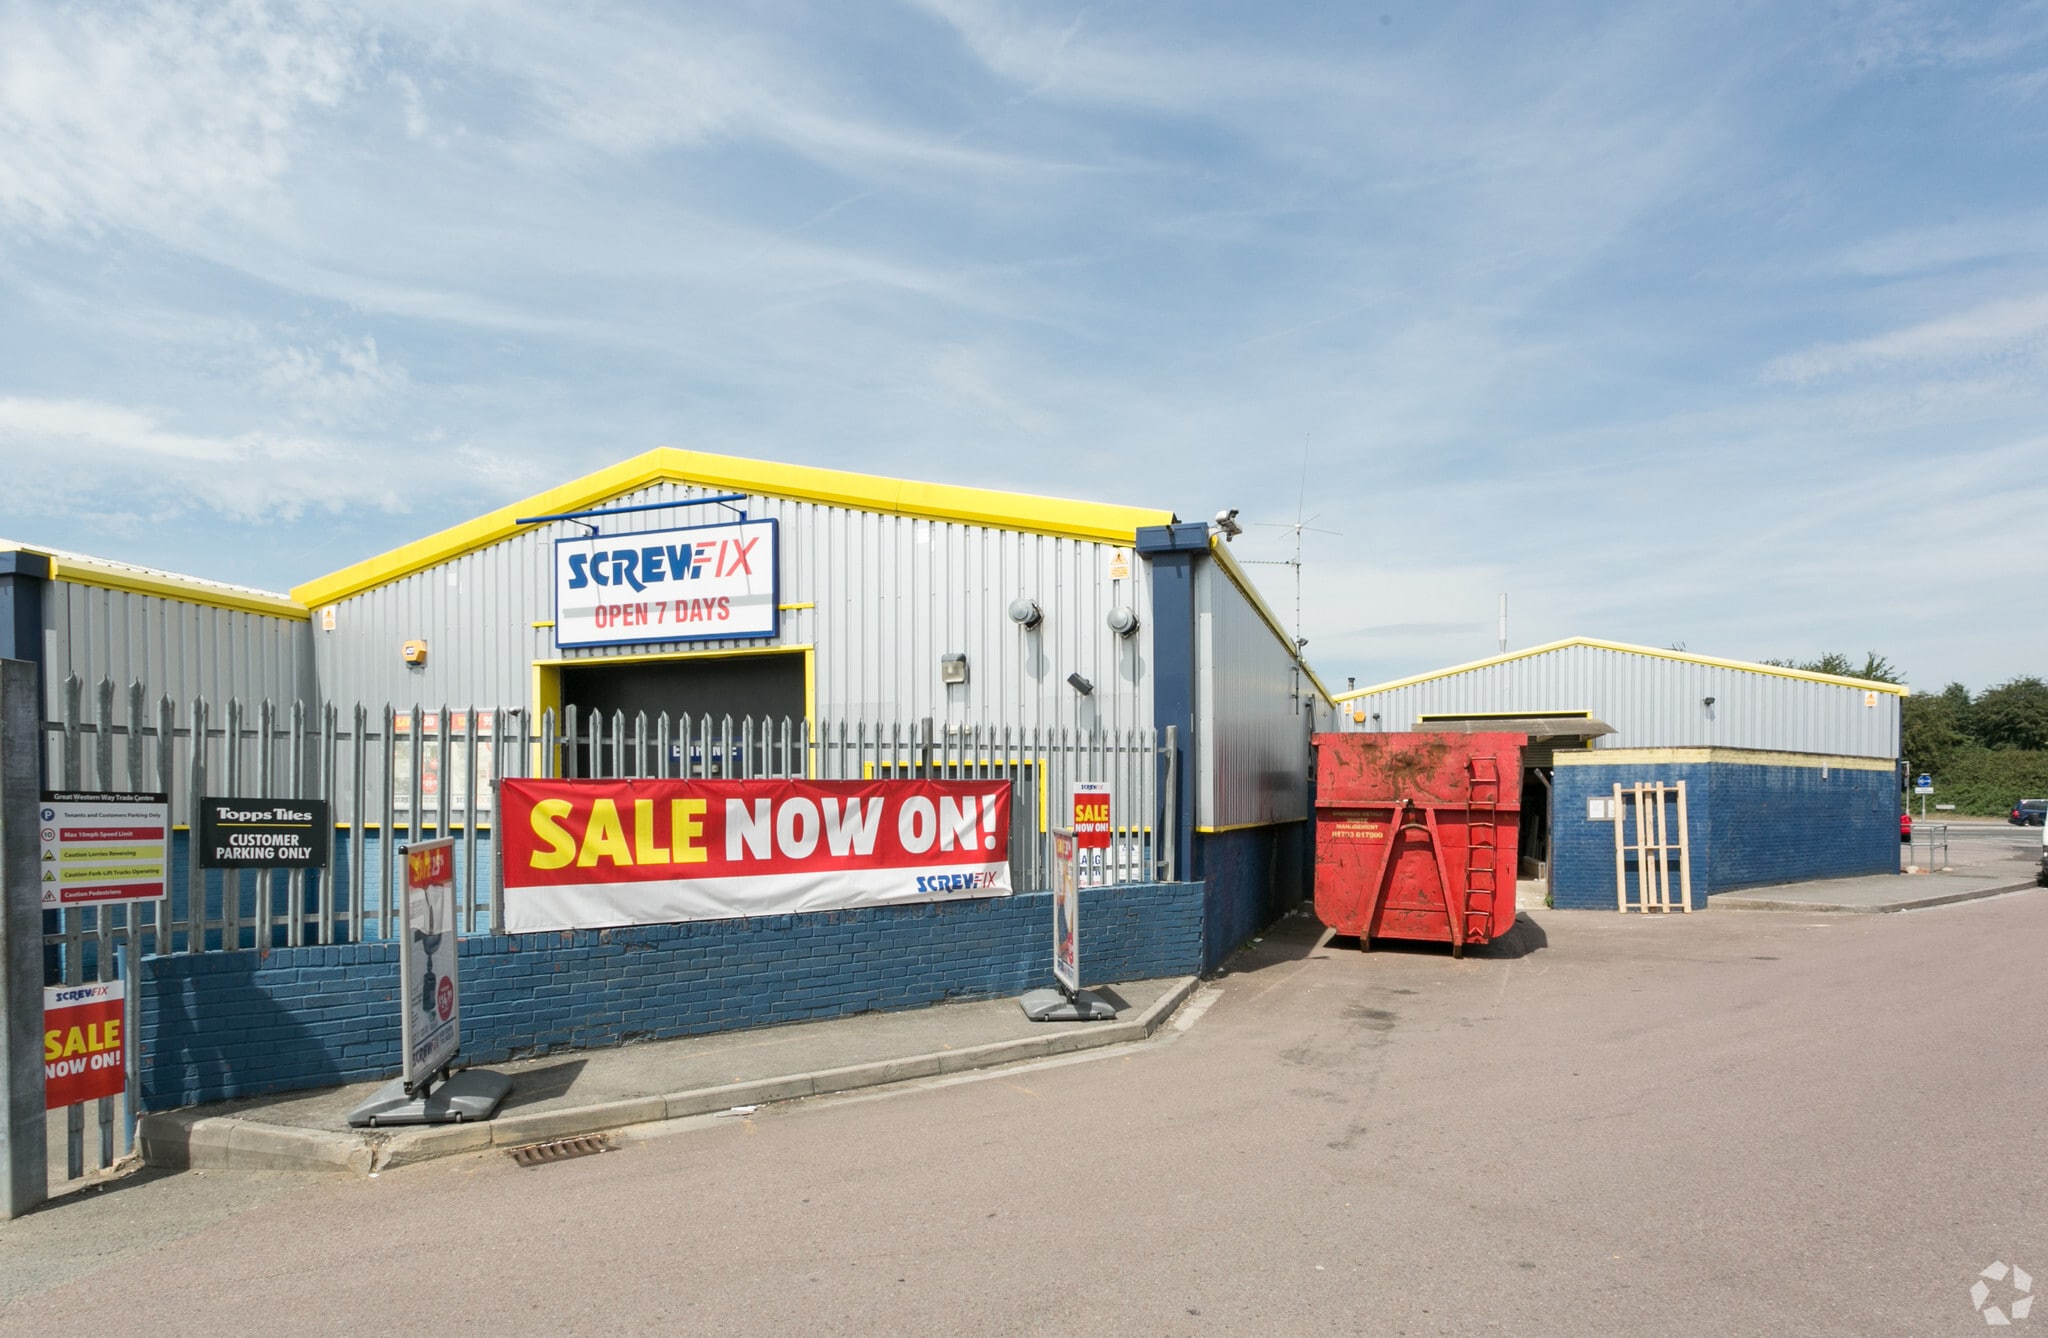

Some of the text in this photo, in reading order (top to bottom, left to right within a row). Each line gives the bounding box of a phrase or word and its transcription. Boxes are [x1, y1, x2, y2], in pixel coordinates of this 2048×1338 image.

[568, 537, 760, 593] SCREWFIX
[594, 596, 730, 629] OPEN 7 DAYS
[53, 793, 73, 801] Great
[73, 793, 100, 801] Western
[100, 794, 115, 802] Way
[115, 794, 133, 802] Trade
[216, 807, 313, 822] Topps Tiles
[1075, 804, 1109, 822] SALE
[78, 831, 99, 839] 10mph
[99, 831, 118, 839] Speed
[529, 794, 997, 870] SALE NOW ON!
[1075, 823, 1109, 832] NOW ON!
[229, 834, 300, 846] CUSTOMER
[109, 850, 137, 858] Reversing
[216, 847, 312, 859] PARKING ONLY
[64, 871, 88, 879] Caution
[113, 868, 132, 876] Trucks
[132, 867, 160, 876] Operating
[916, 871, 998, 893] SCREWFIX
[64, 889, 122, 899] Caution Pedestrians
[56, 986, 109, 1001] SCREWFIX
[44, 1019, 121, 1061] SALE
[45, 1050, 121, 1080] NOW ON!
